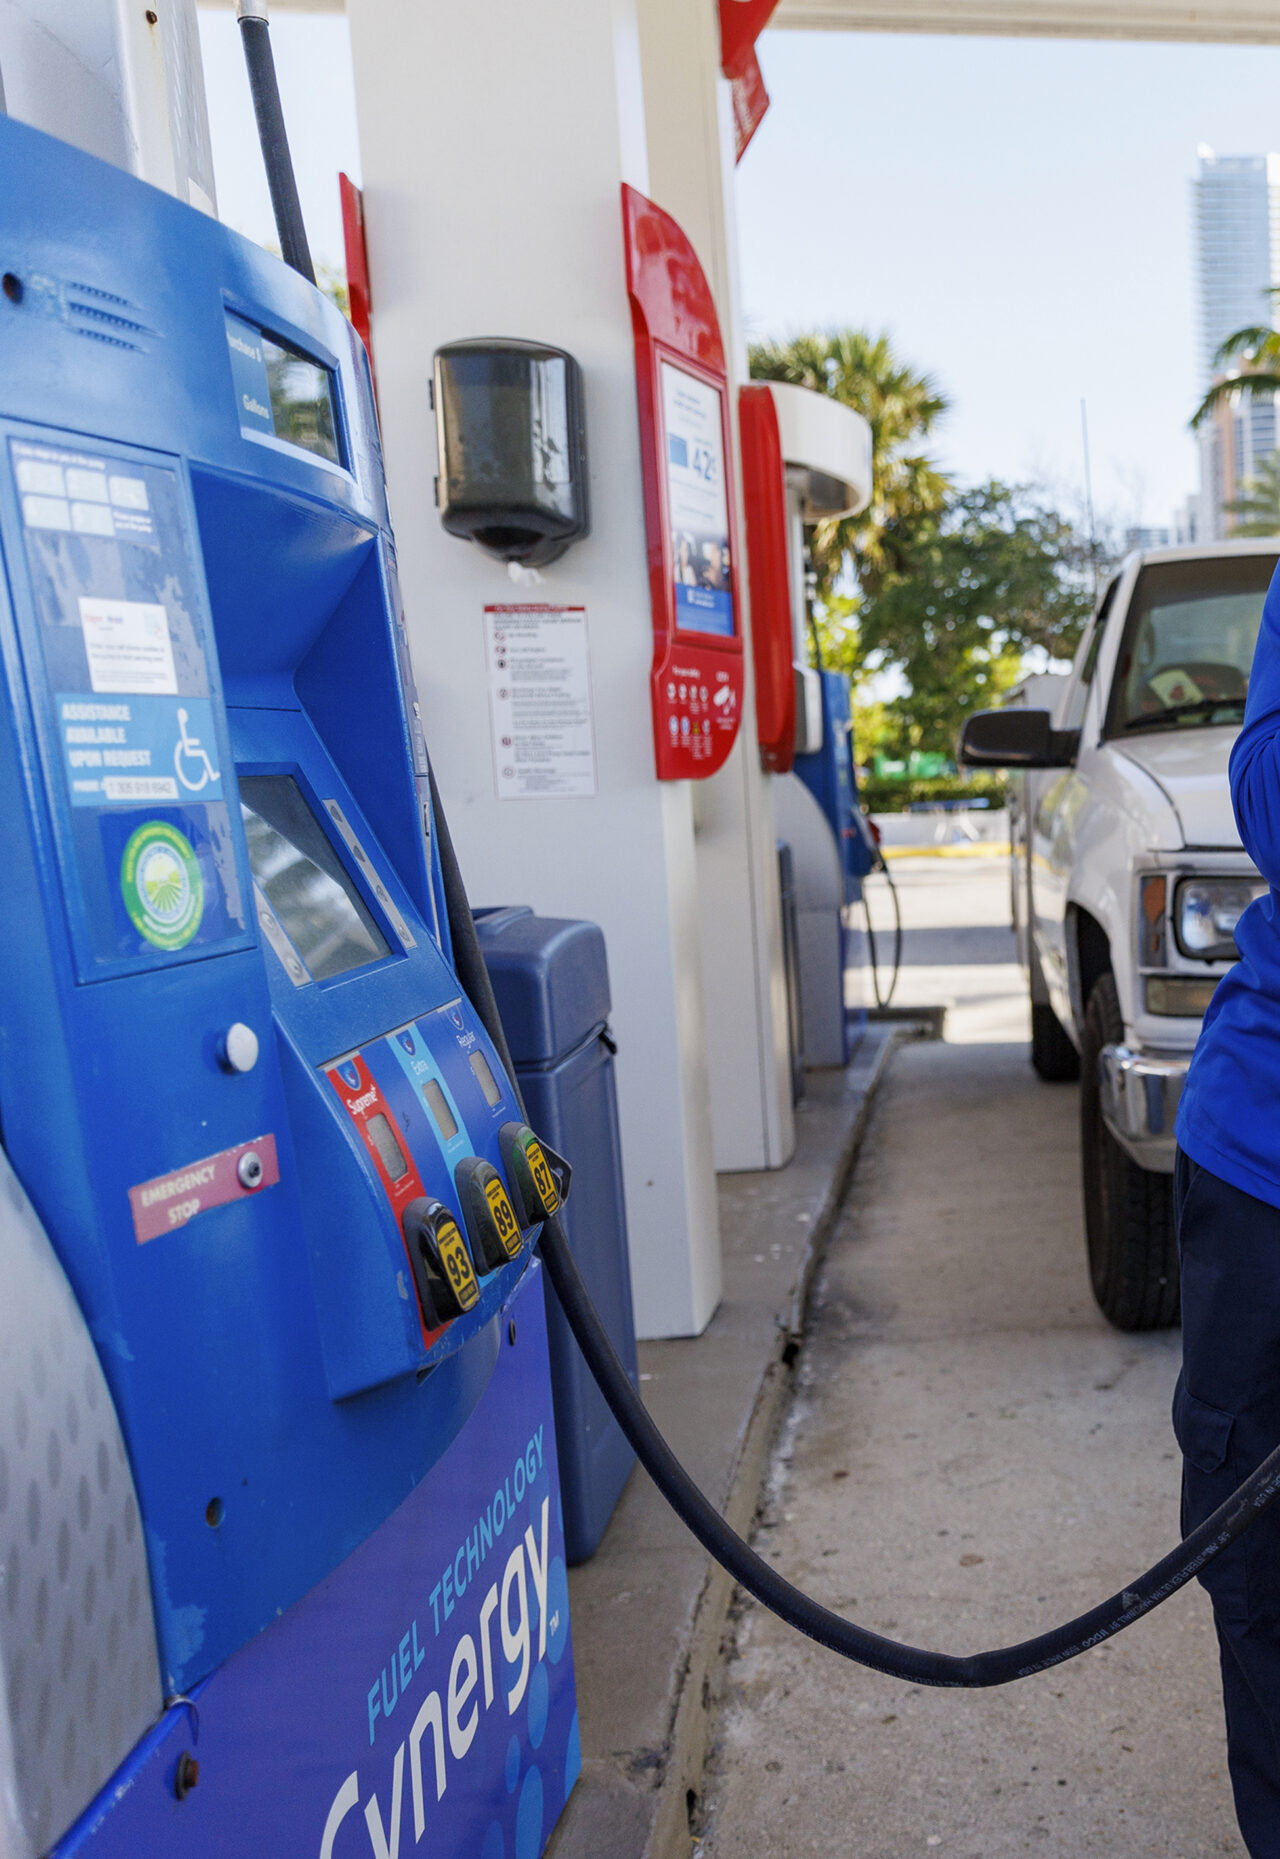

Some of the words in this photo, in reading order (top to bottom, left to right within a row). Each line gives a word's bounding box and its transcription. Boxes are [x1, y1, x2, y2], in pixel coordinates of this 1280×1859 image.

[62, 703, 131, 721] ASSISTANCE
[66, 727, 127, 744] AVAILABLE
[69, 750, 102, 768] UPON
[103, 750, 151, 767] REQUEST
[410, 1060, 429, 1075] Extra
[140, 1164, 216, 1208] EMERGENCY
[534, 1166, 551, 1197] 87
[167, 1198, 200, 1225] STOP
[494, 1202, 514, 1238] 89
[446, 1246, 469, 1287] 93
[367, 1620, 425, 1746] FUEL
[428, 1423, 544, 1637] TECHNOLOGY
[549, 1609, 560, 1637] TM
